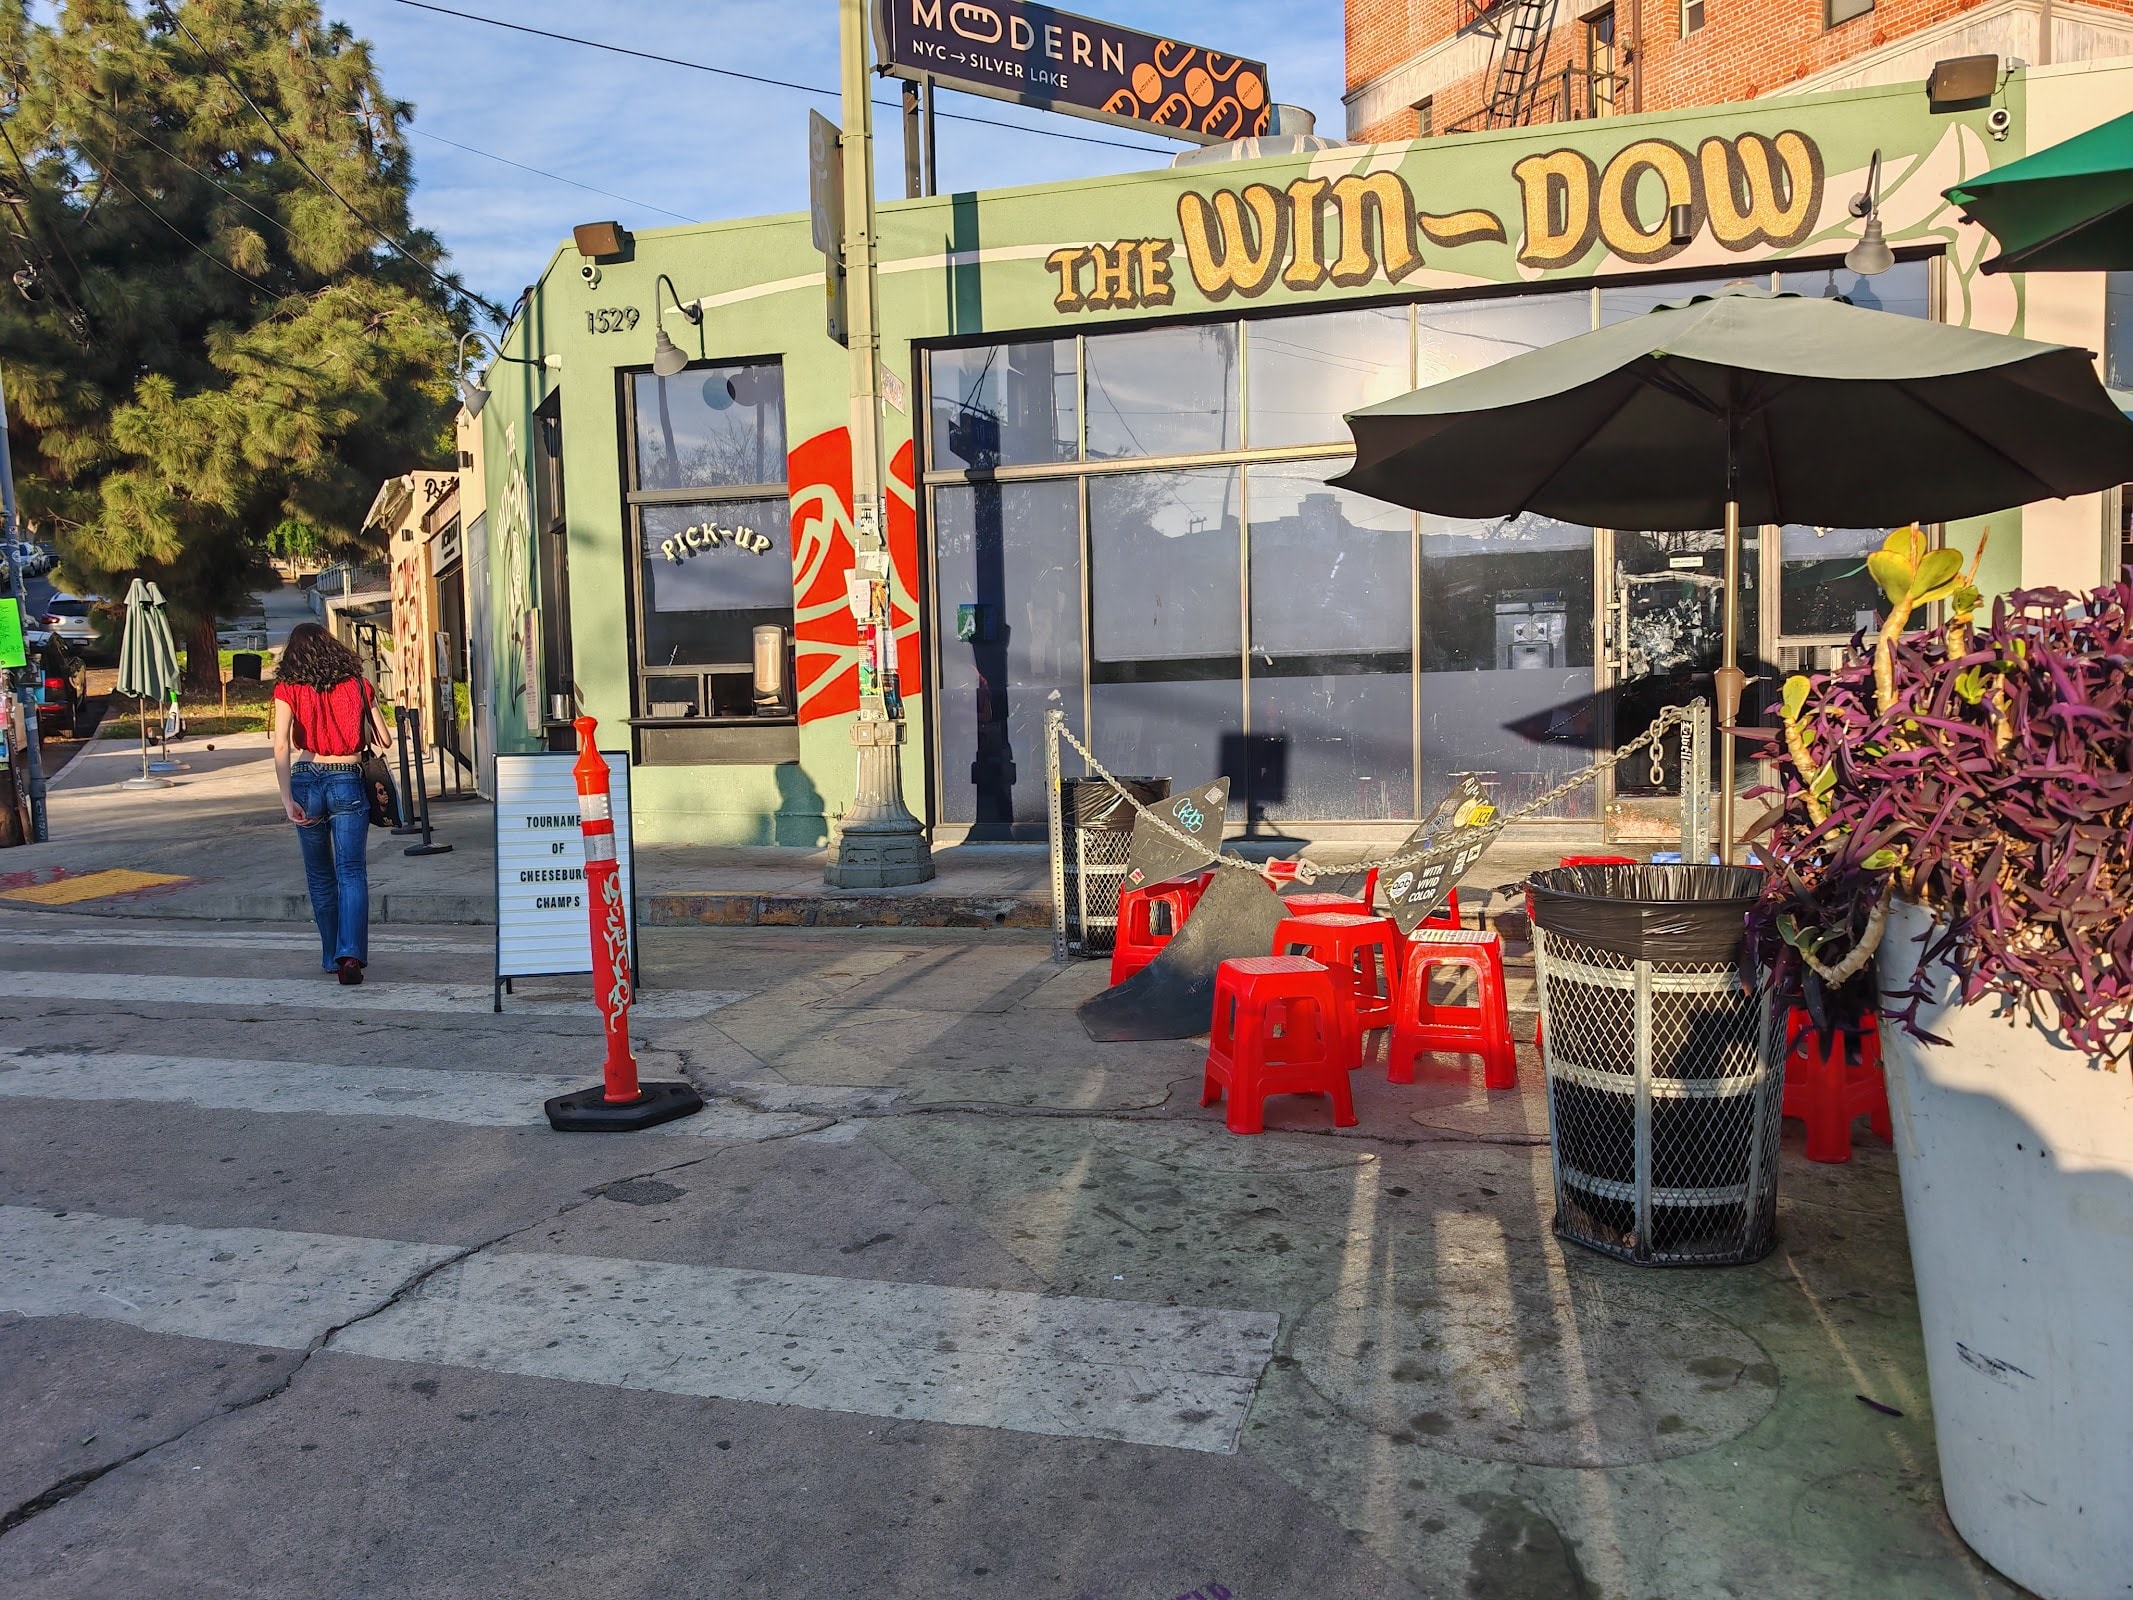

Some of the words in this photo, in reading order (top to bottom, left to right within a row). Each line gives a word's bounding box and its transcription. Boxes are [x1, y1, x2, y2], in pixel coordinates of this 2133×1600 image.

[912, 0, 1125, 75] MODERN
[913, 40, 947, 60] NYC
[970, 53, 1024, 79] SILVER
[1030, 67, 1068, 88] LAKE
[1044, 237, 1175, 313] THE
[1176, 129, 1823, 303] WIN-DOW
[585, 306, 640, 334] 1529
[660, 522, 771, 562] PICK-UP
[526, 815, 581, 828] TOURNAME
[552, 842, 565, 854] OF
[1422, 864, 1445, 879] WITH
[1416, 876, 1440, 890] VIVID
[536, 896, 580, 908] CHAMPS
[1408, 888, 1436, 903] COLOR
